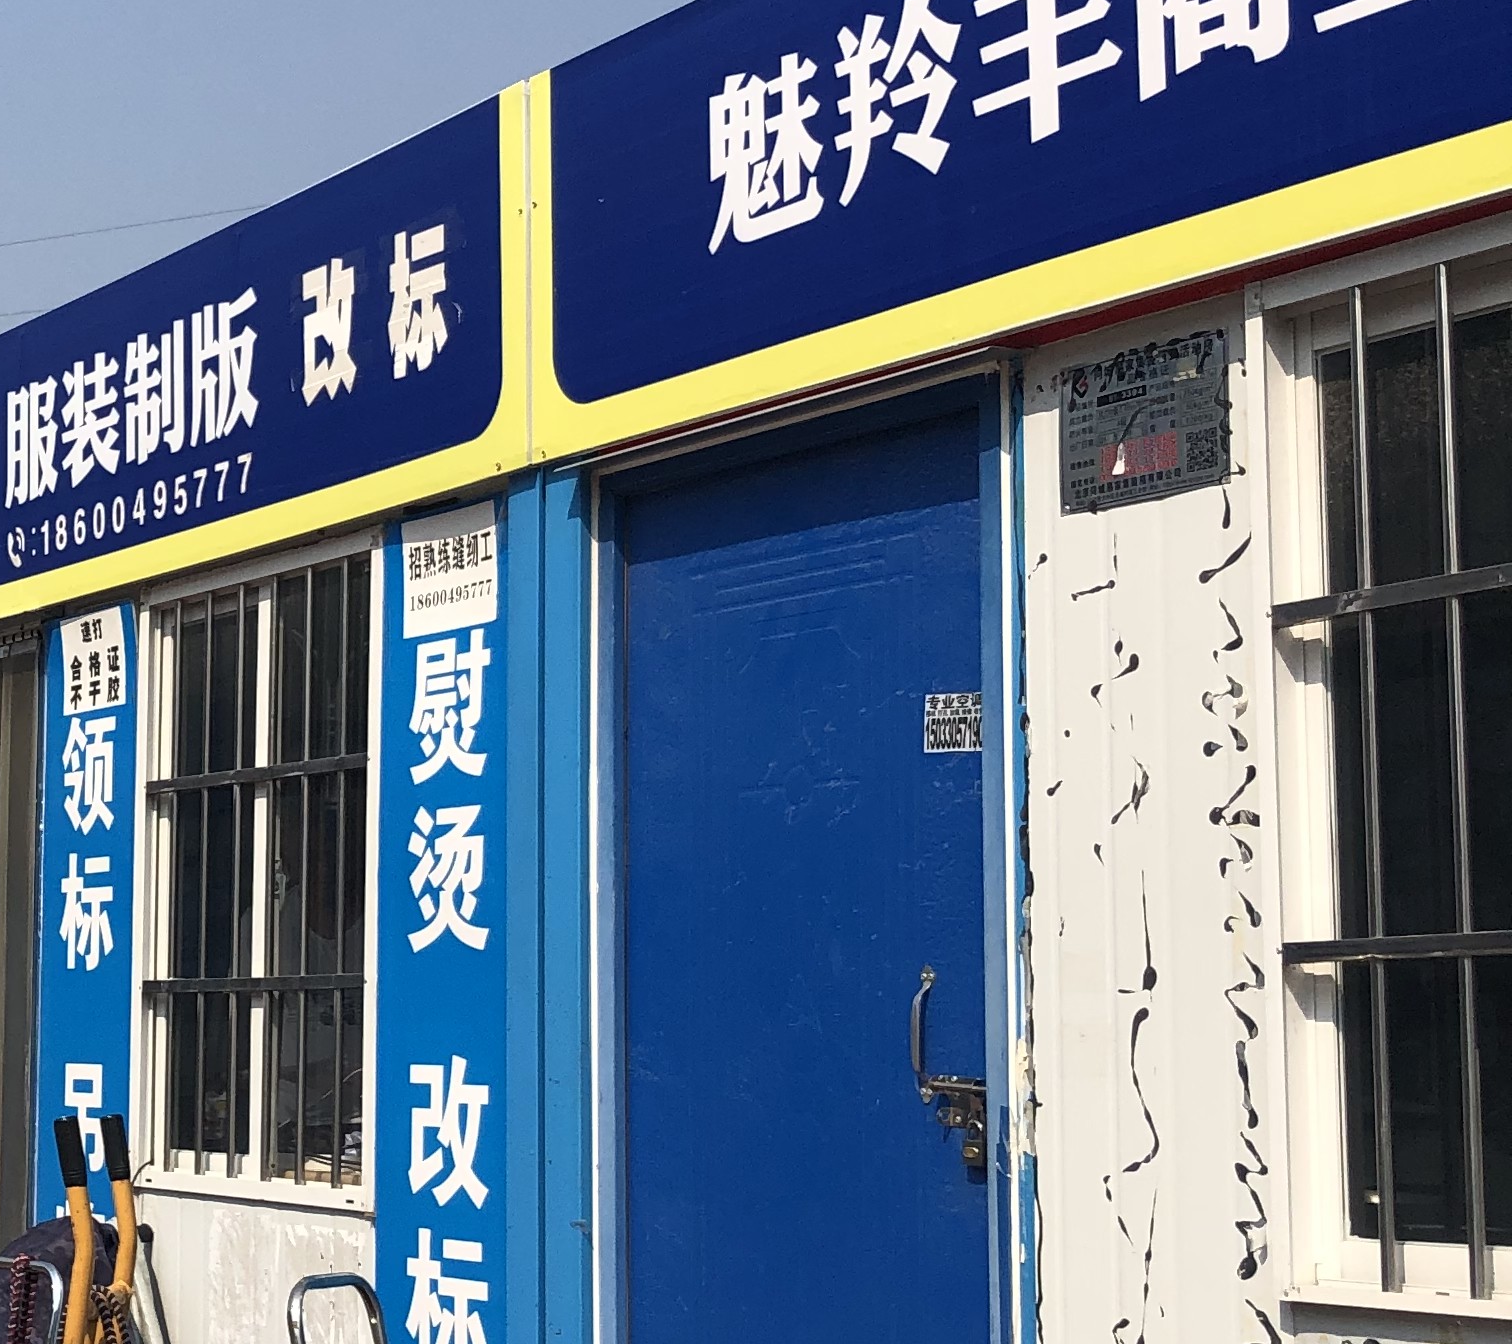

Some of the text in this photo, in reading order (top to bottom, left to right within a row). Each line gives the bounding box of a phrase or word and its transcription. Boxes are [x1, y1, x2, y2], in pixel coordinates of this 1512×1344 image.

[4, 286, 259, 511] 服装制版
[301, 223, 449, 407] 改标
[408, 531, 493, 582] 招熟练缝纫工
[410, 579, 493, 612] 18600495777
[80, 618, 103, 643] 速打
[70, 645, 120, 682] 合格证
[70, 676, 120, 711] 不干胶
[407, 627, 491, 954] 熨烫
[59, 716, 116, 973] 领标
